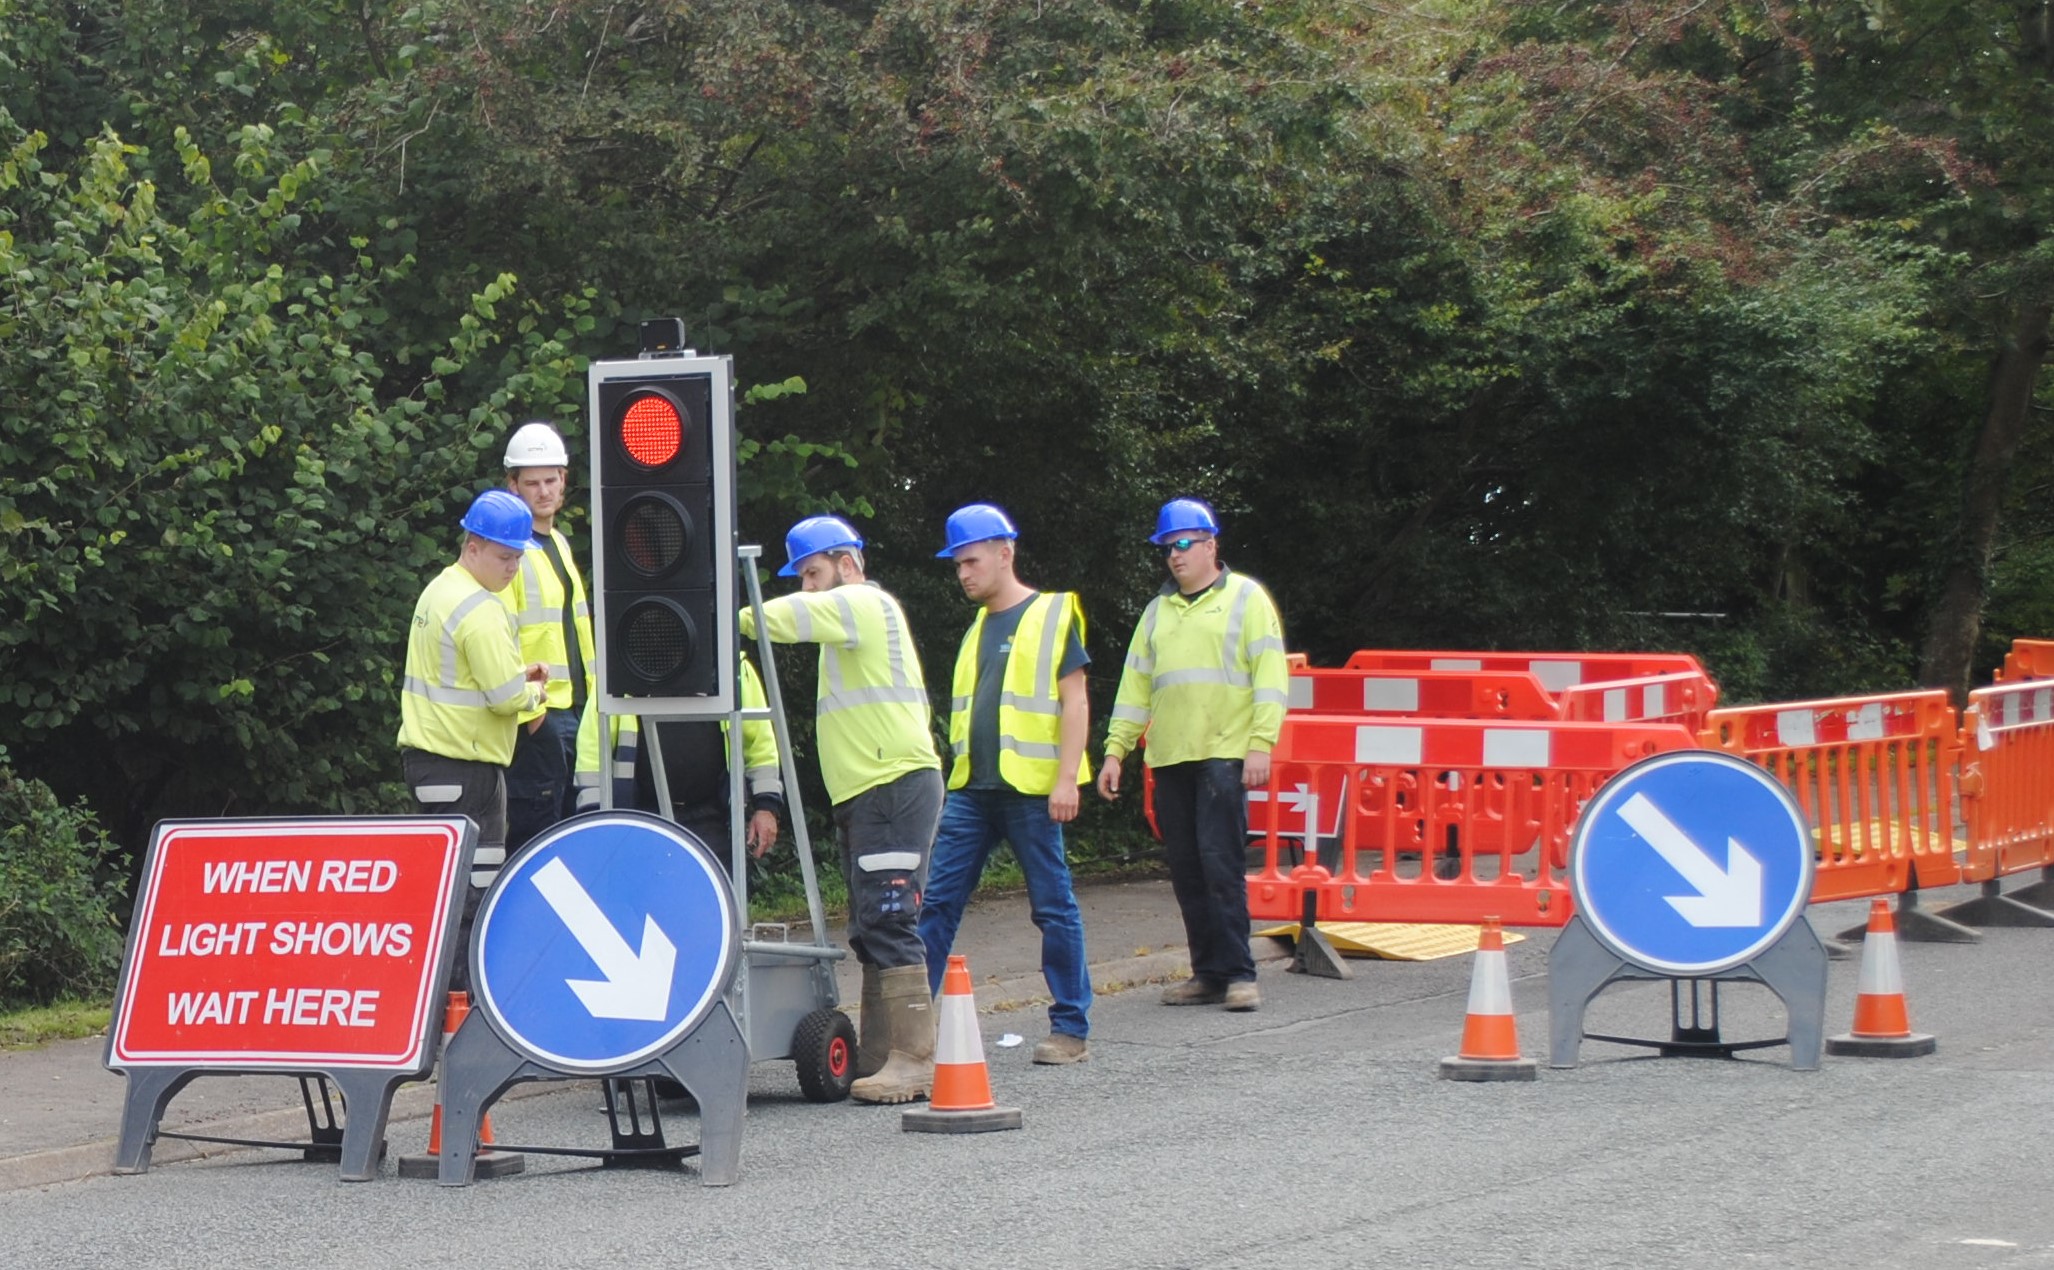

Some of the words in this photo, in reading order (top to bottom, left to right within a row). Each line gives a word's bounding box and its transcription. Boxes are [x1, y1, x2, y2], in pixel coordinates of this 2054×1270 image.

[204, 861, 312, 893] WHEN
[318, 861, 397, 892] RED
[160, 923, 266, 956] LIGHT
[270, 923, 412, 956] SHOWS
[169, 990, 259, 1025] WAIT
[264, 989, 380, 1027] HERE
